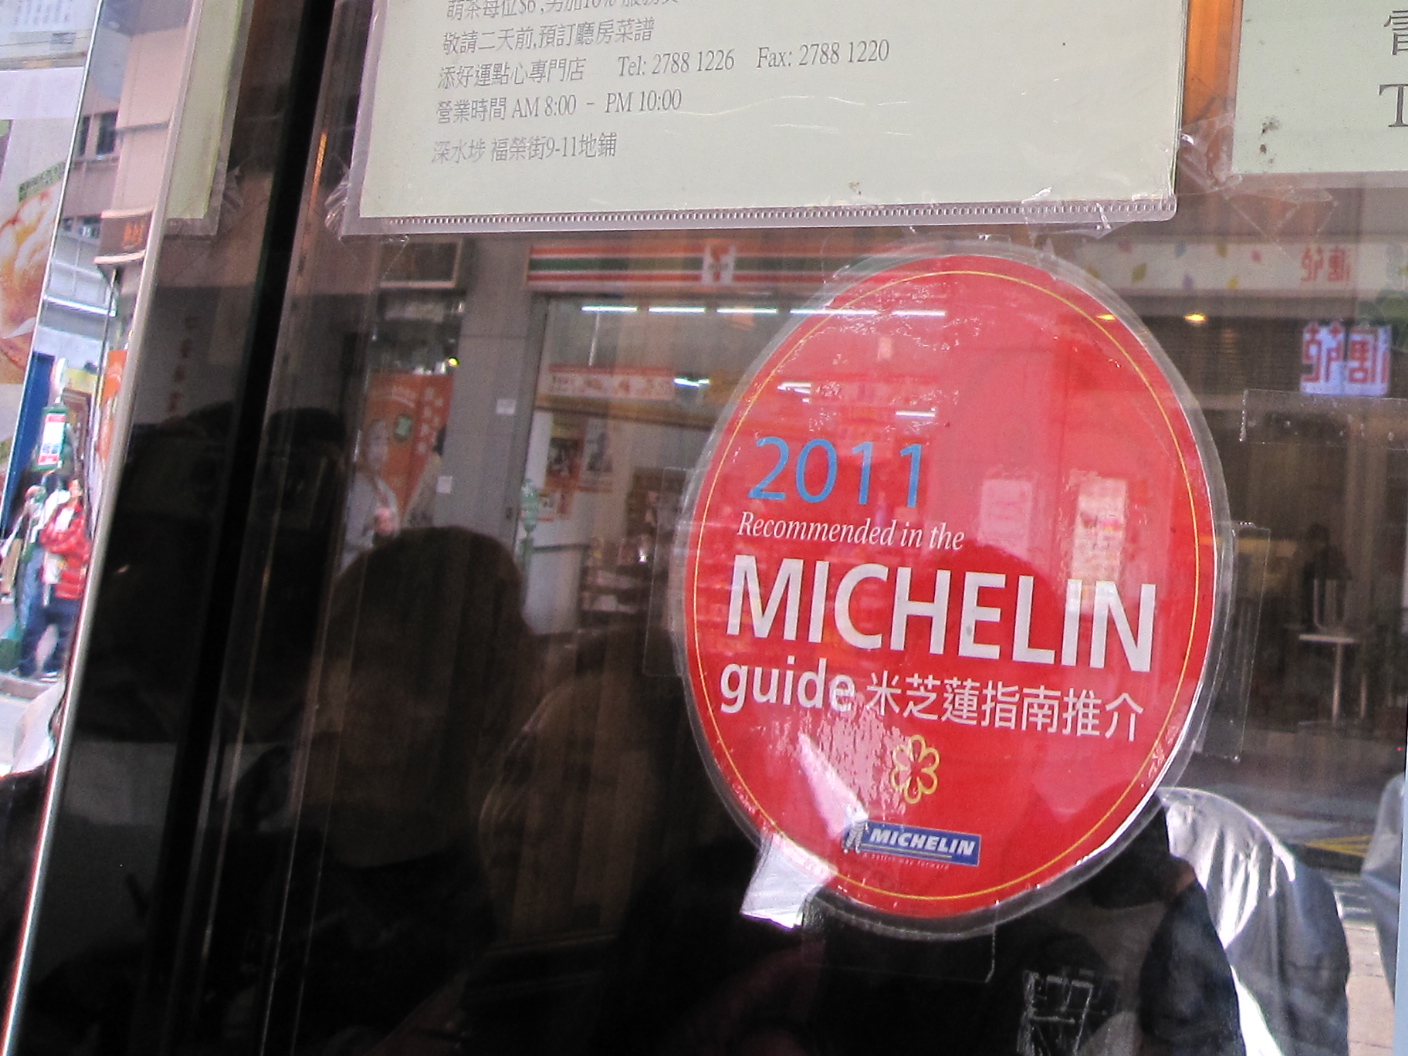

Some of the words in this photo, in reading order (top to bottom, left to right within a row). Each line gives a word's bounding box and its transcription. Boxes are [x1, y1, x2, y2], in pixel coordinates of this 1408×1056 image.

[438, 56, 587, 90] 添好運點心專門店
[617, 52, 647, 79] Tel:
[651, 50, 691, 76] 2788
[695, 47, 736, 73] 1226
[756, 45, 792, 70] Fax:
[798, 42, 841, 67] 2788
[846, 39, 890, 64] 1220
[435, 95, 506, 125] 營業時間
[511, 96, 540, 119] AM
[543, 93, 577, 117] 8:00
[604, 91, 635, 115] PM
[637, 88, 682, 113] 10:00
[746, 434, 923, 508] 2011
[737, 509, 895, 550] Recommended
[900, 521, 923, 547] in
[927, 523, 965, 552] the
[724, 555, 1157, 673] MICHELIN
[719, 658, 855, 715] guide
[866, 669, 1144, 743] 米芝蓮指南推介
[868, 828, 976, 857] MICHELIN
